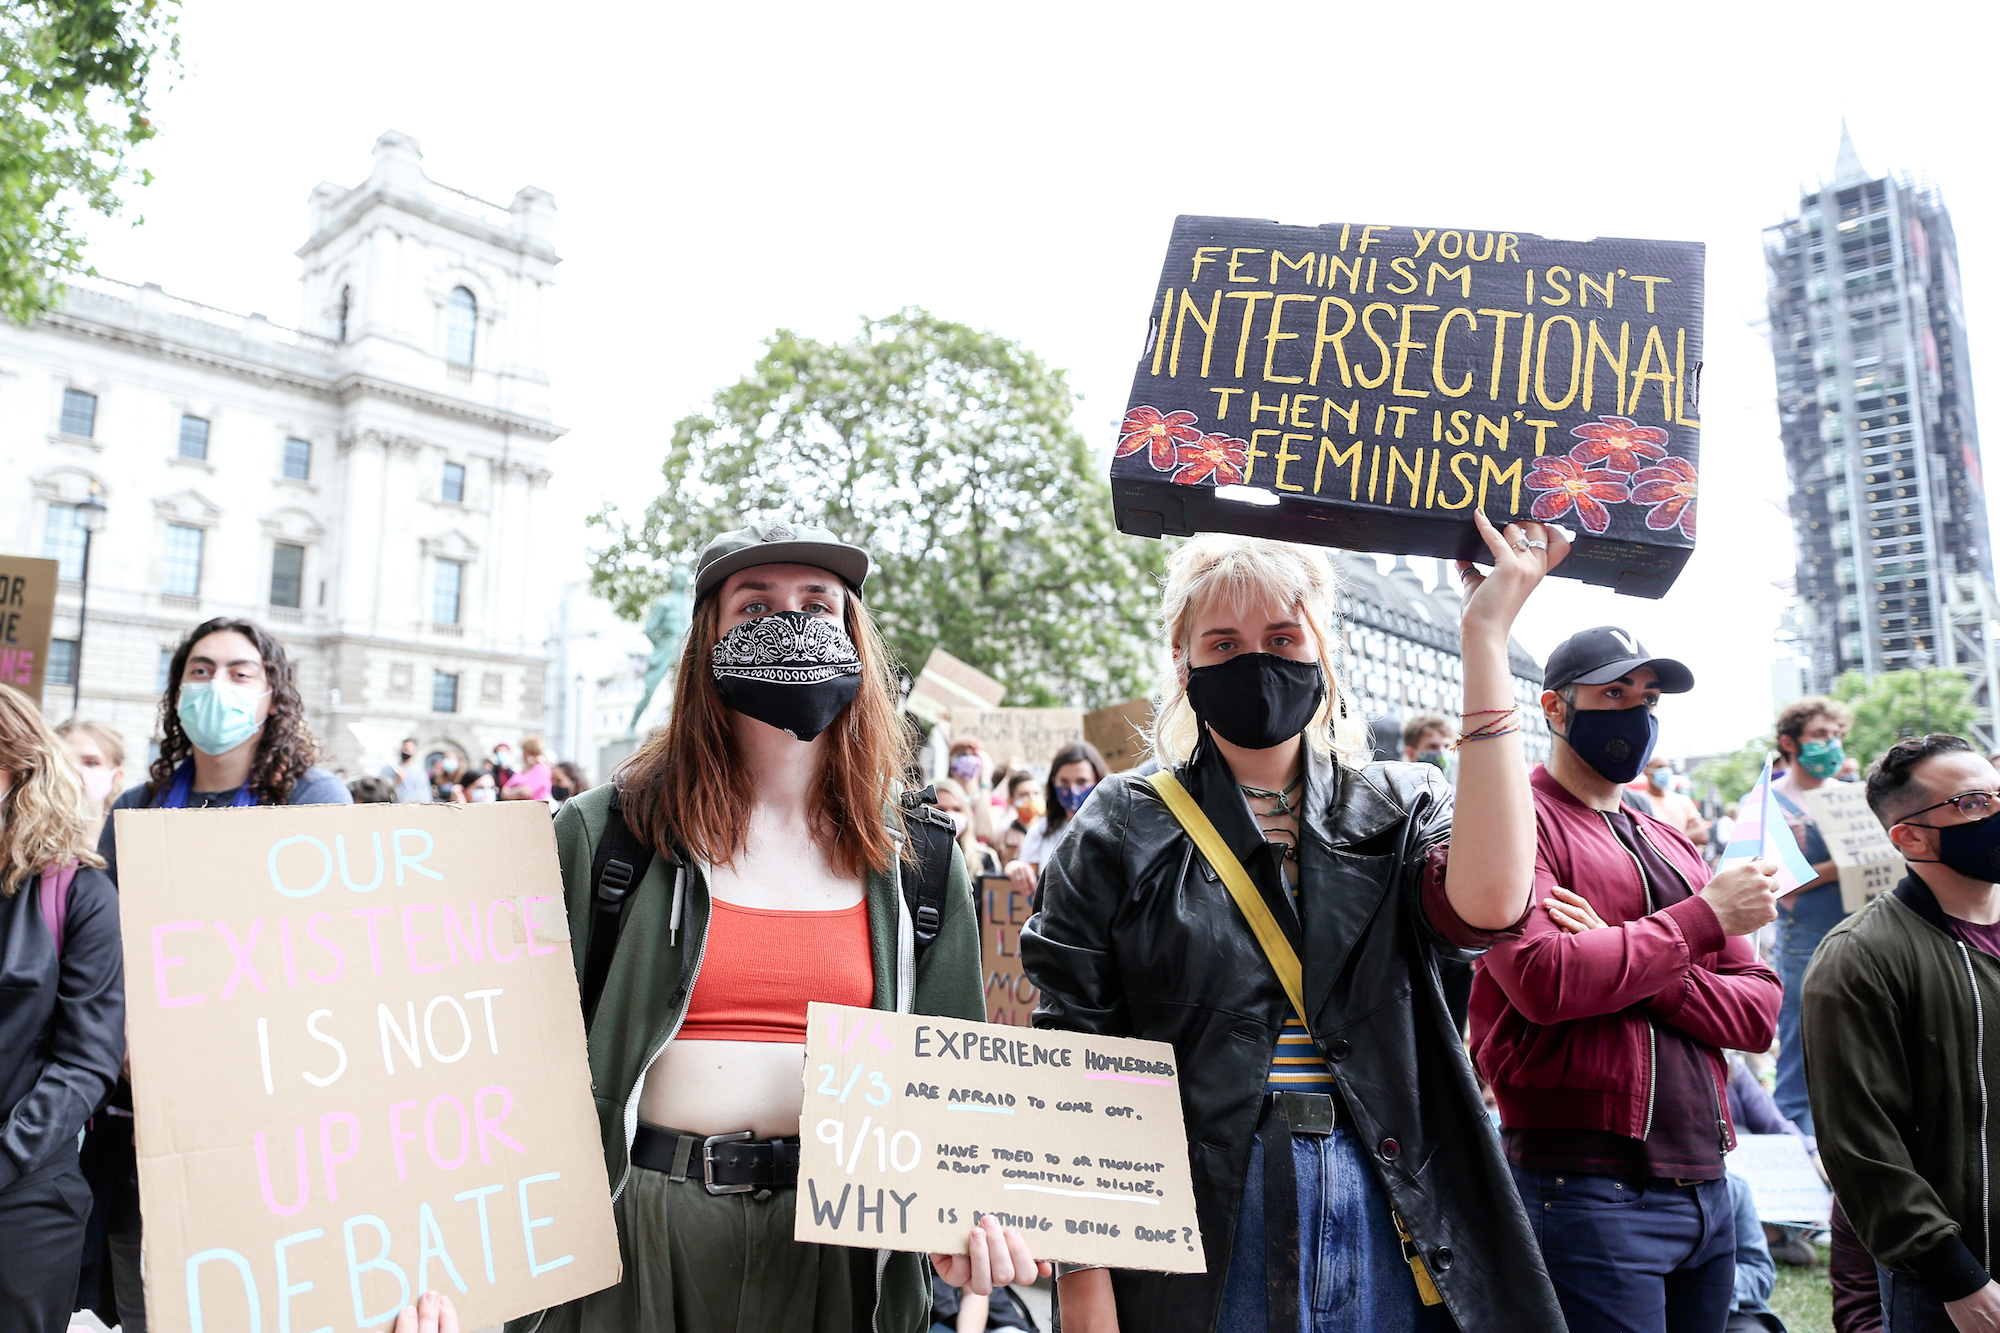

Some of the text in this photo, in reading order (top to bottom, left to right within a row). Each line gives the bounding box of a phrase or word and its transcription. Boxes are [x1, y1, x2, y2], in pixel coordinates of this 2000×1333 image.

[1340, 223, 1520, 263] IF YOUR
[1191, 246, 1672, 314] FEMINISM ISN'T
[1151, 287, 1700, 428] INTERSECTIONAL
[1209, 387, 1558, 457] THEN IT ISN'T
[1244, 428, 1525, 516] FEMINISM
[268, 828, 445, 898] OUR
[151, 896, 557, 1008] EXISTENCE
[985, 969, 1040, 1005] MO
[256, 988, 503, 1095] IS NOT
[825, 1013, 895, 1056] 1/4
[915, 1025, 1072, 1067] EXPERIENCE
[817, 1062, 1143, 1121] 2/3 ARE AFRAID TO COME OUT.
[254, 1085, 526, 1216] UP FOR
[815, 1115, 1164, 1175] 9/10 HAVE TRIED TO OR THOUGHT
[936, 1160, 1164, 1197] ABOUT COMMITING SUICIDE.
[807, 1178, 918, 1234] WHY
[938, 1208, 958, 1224] IS
[1065, 1219, 1121, 1238] BEING
[185, 1171, 574, 1333] DEBATE
